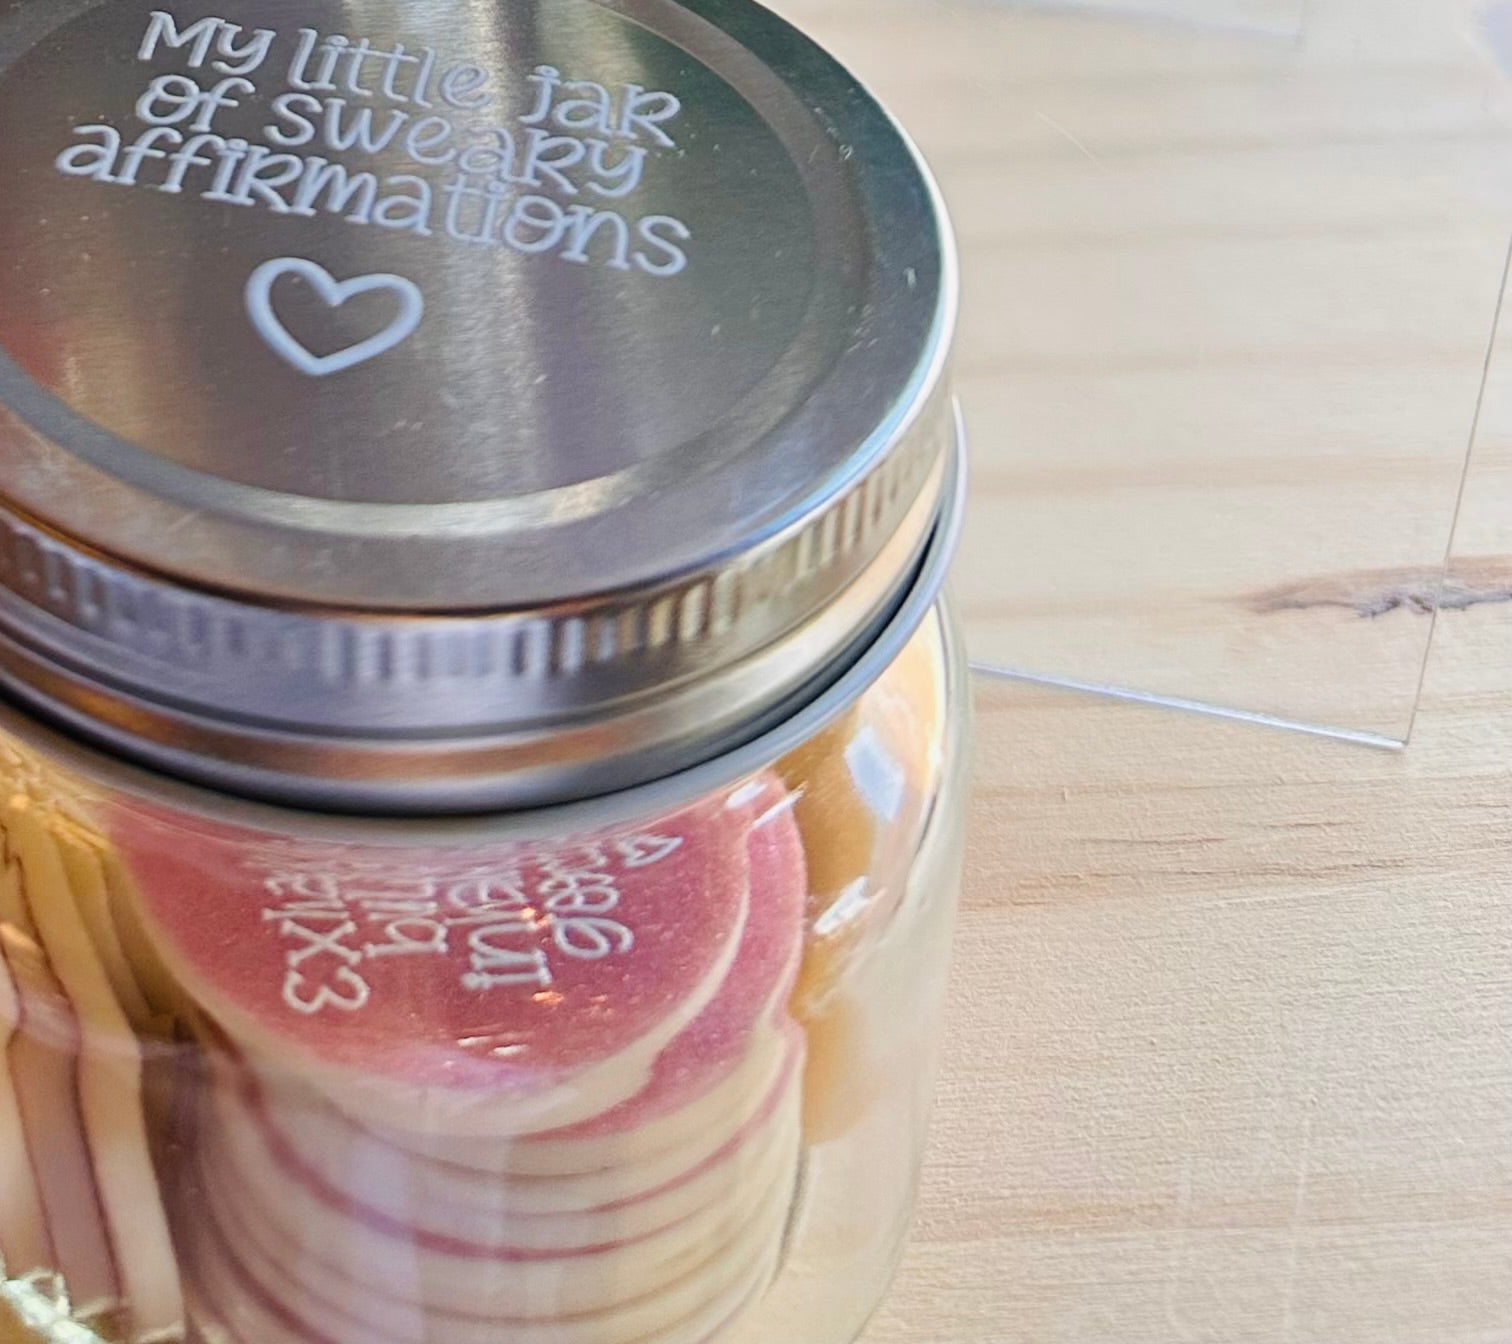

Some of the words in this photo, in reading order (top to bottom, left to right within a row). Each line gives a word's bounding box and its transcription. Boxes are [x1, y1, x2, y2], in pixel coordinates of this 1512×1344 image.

[137, 10, 277, 74] My
[288, 27, 489, 111] little
[134, 73, 256, 132] of
